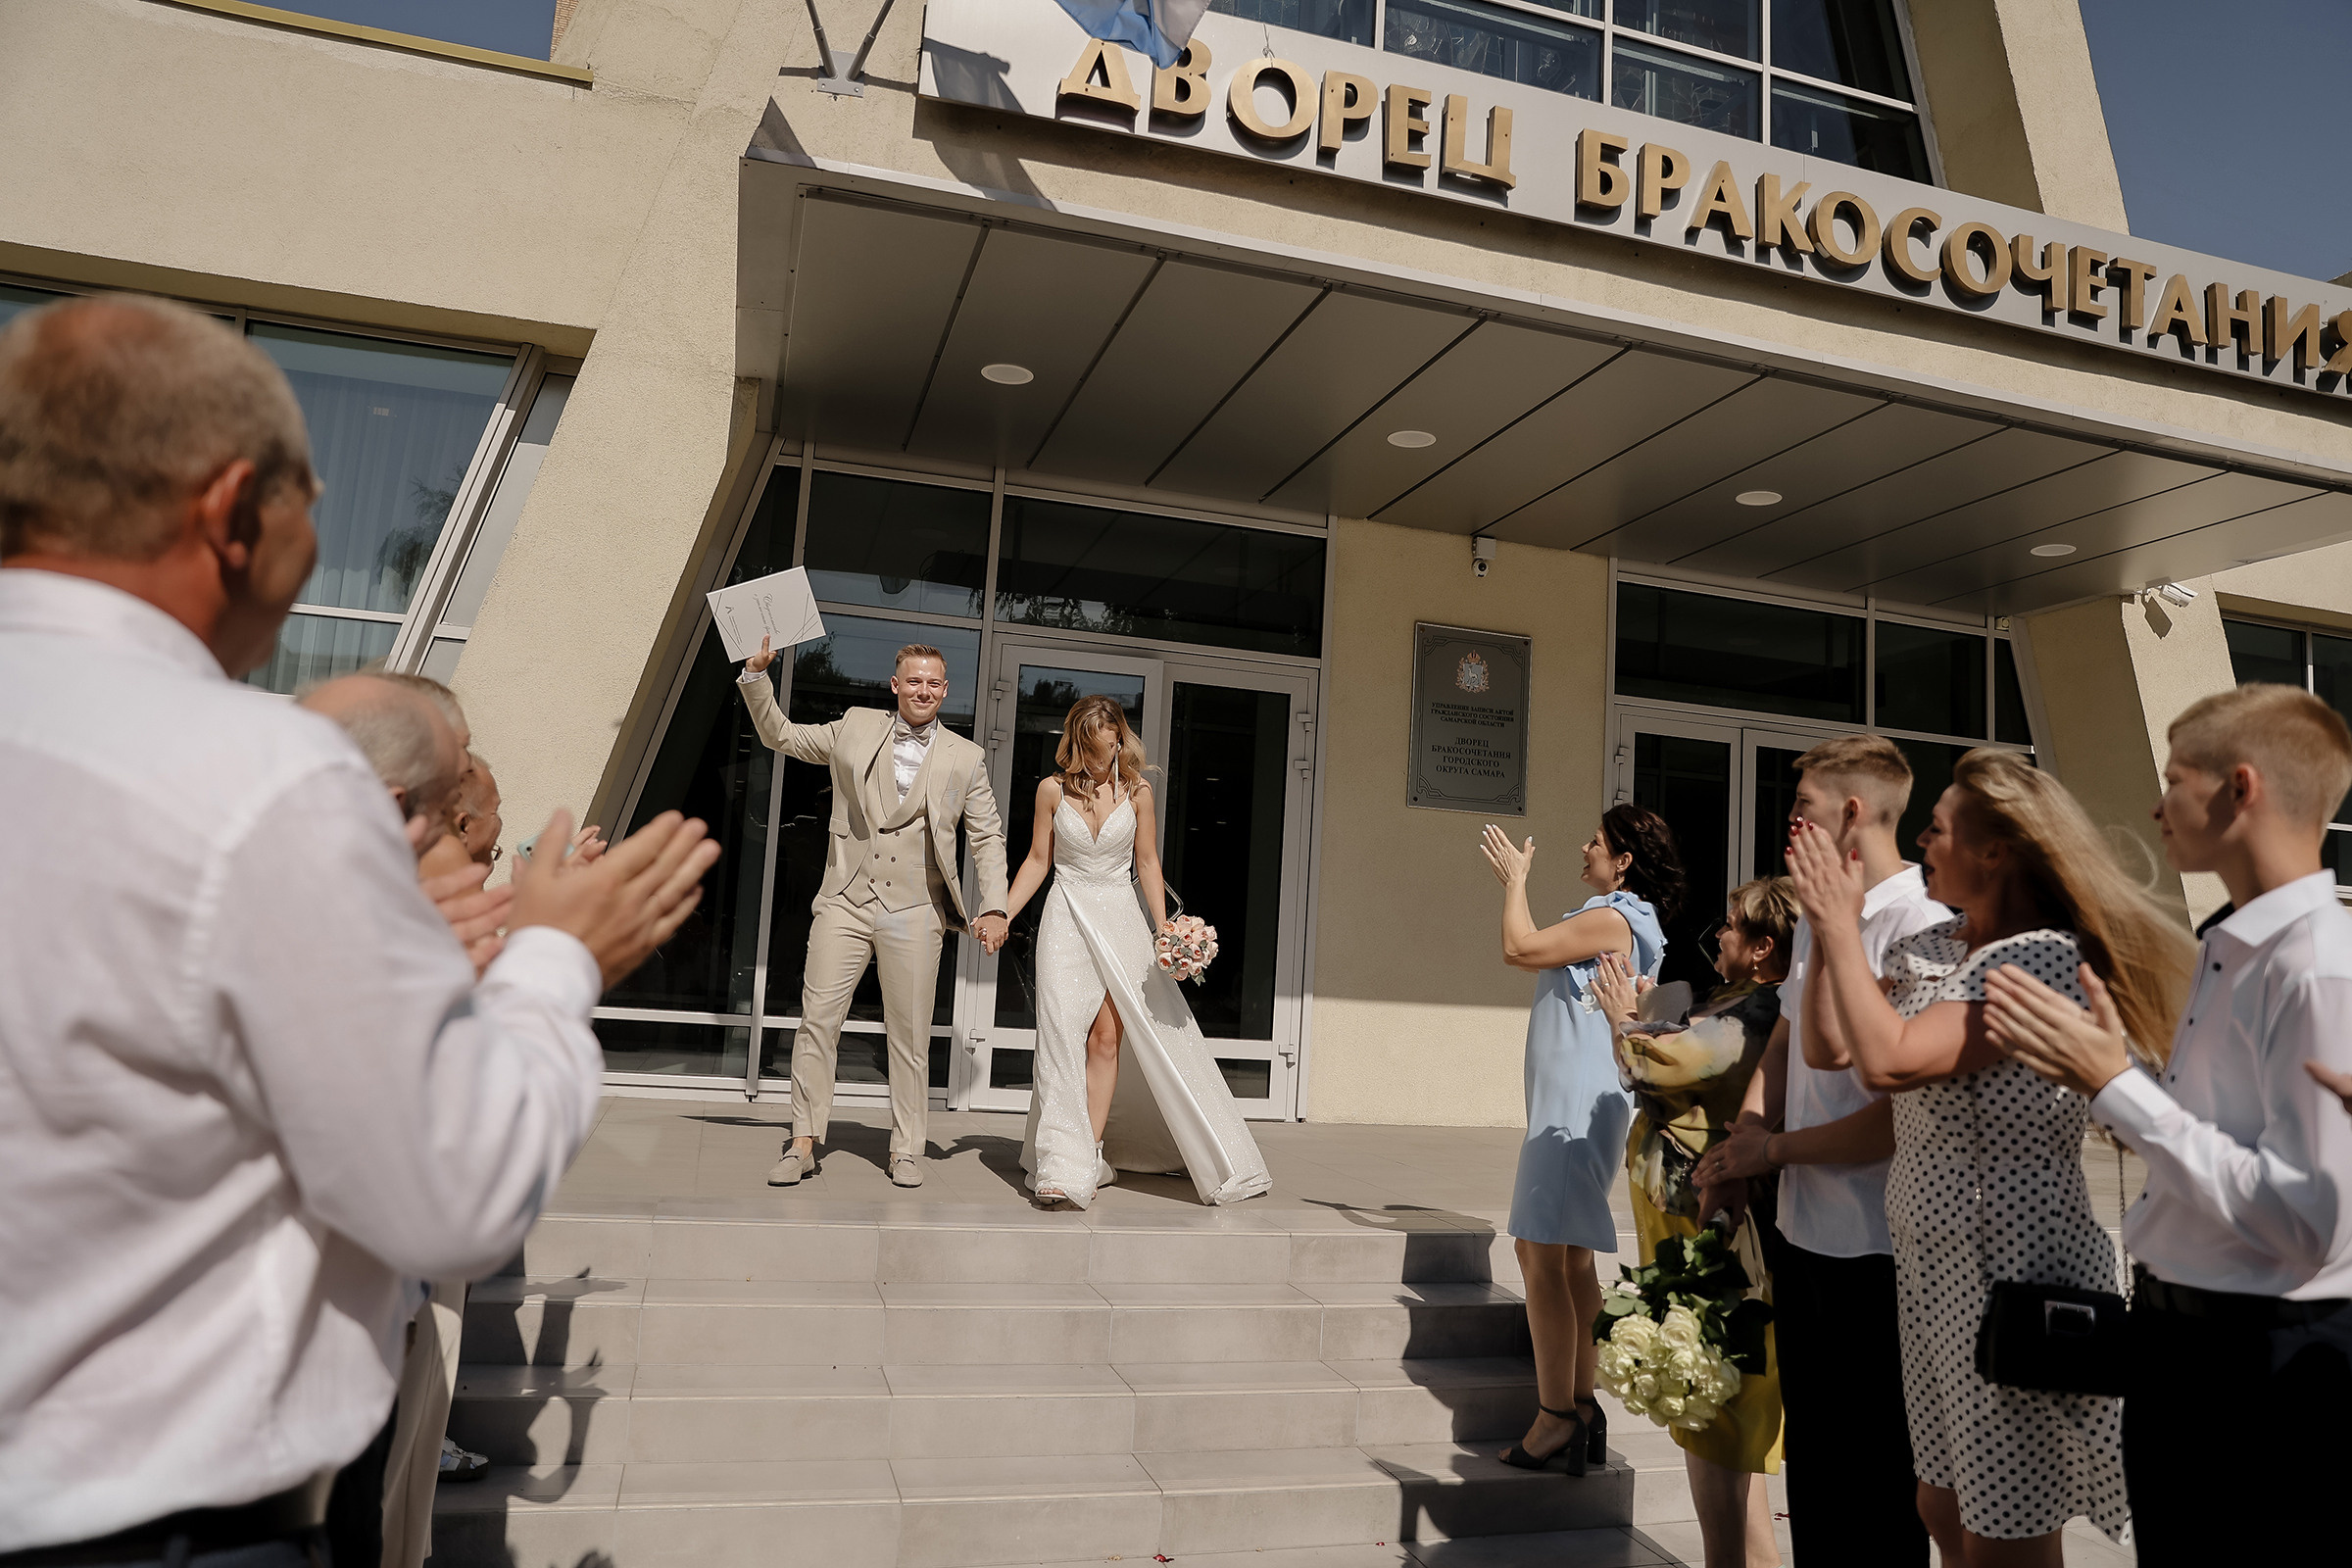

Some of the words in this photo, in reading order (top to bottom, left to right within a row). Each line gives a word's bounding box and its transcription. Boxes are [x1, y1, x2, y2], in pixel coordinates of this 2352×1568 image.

[1057, 37, 1516, 190] ДВОРЕЦ
[1454, 737, 1489, 749] ДВОРЕЦ
[1431, 745, 1511, 760] БРАКОСОЧЕТАНИЯ
[1443, 756, 1499, 768] ГОРОДСКОГО
[1436, 764, 1469, 775] ОКРУГА
[1471, 767, 1505, 778] САМАРА
